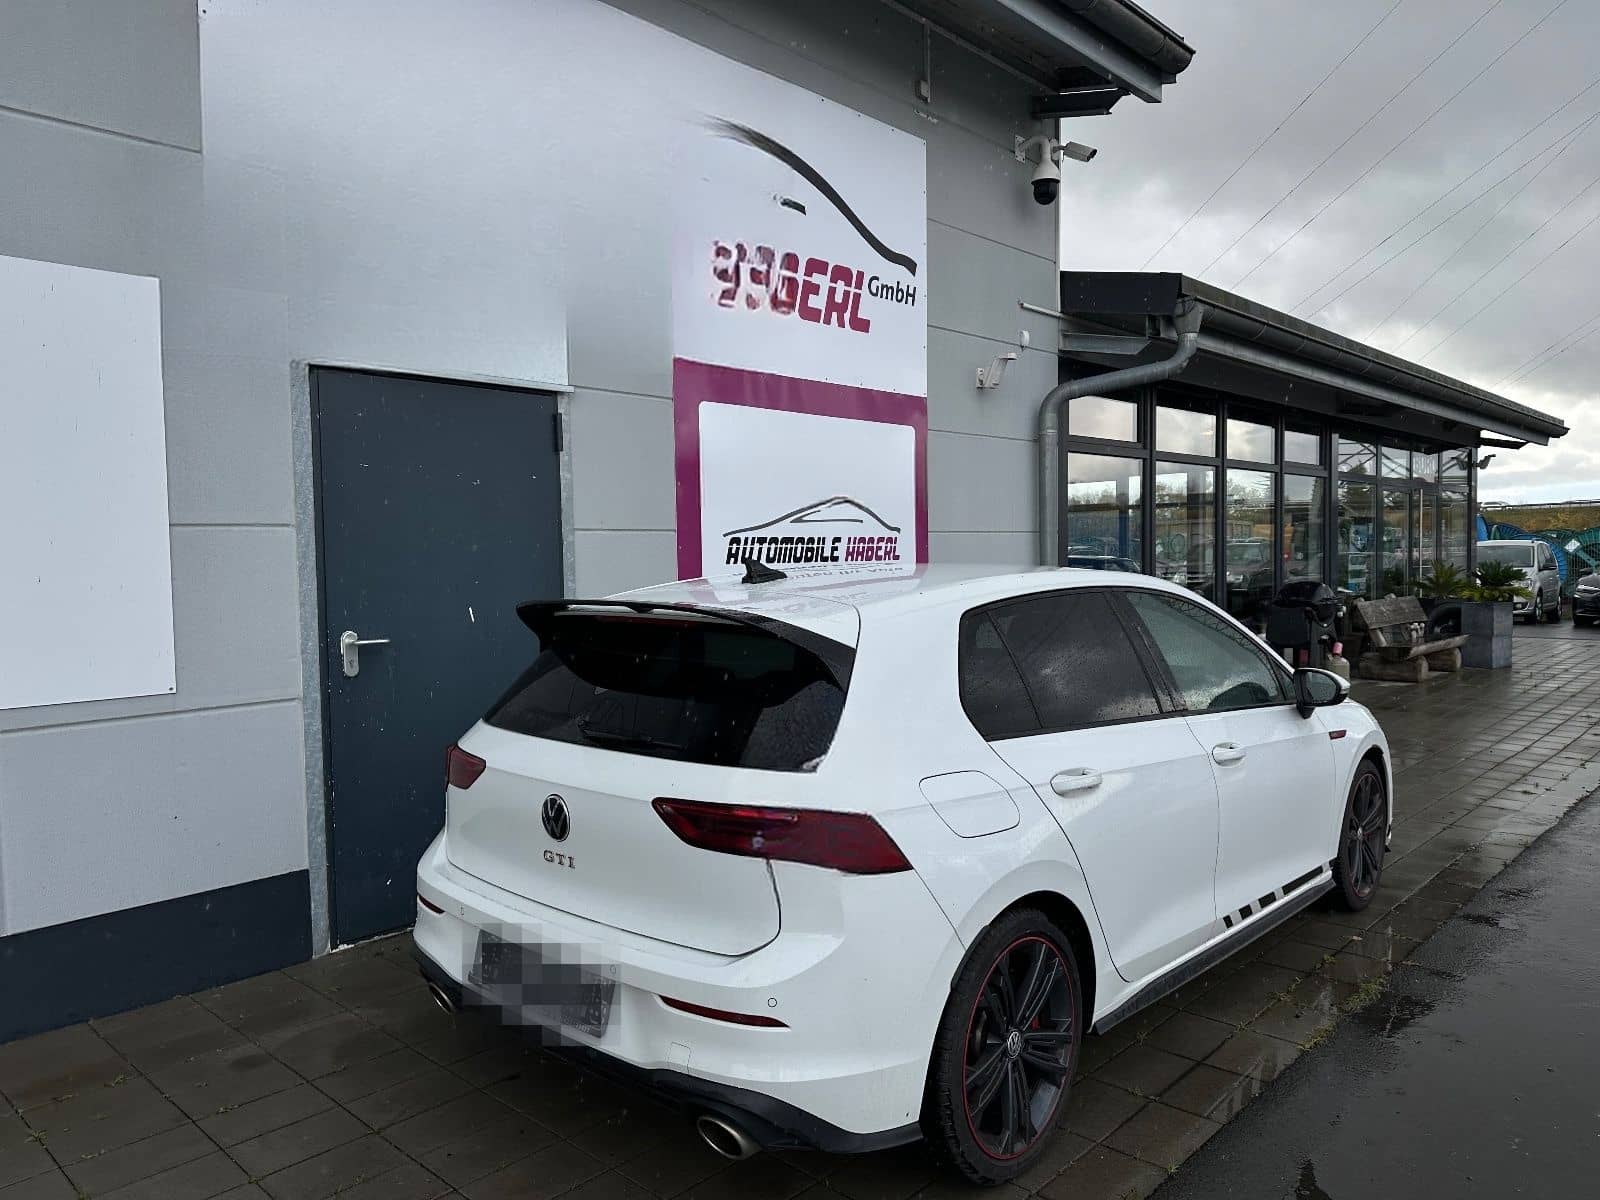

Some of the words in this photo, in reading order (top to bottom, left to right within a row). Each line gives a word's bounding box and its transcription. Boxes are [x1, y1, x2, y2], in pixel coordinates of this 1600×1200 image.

[867, 275, 917, 307] GmbH
[725, 536, 842, 565] AUTOMOBILE
[844, 536, 901, 562] HABERL
[543, 849, 576, 869] GTI
